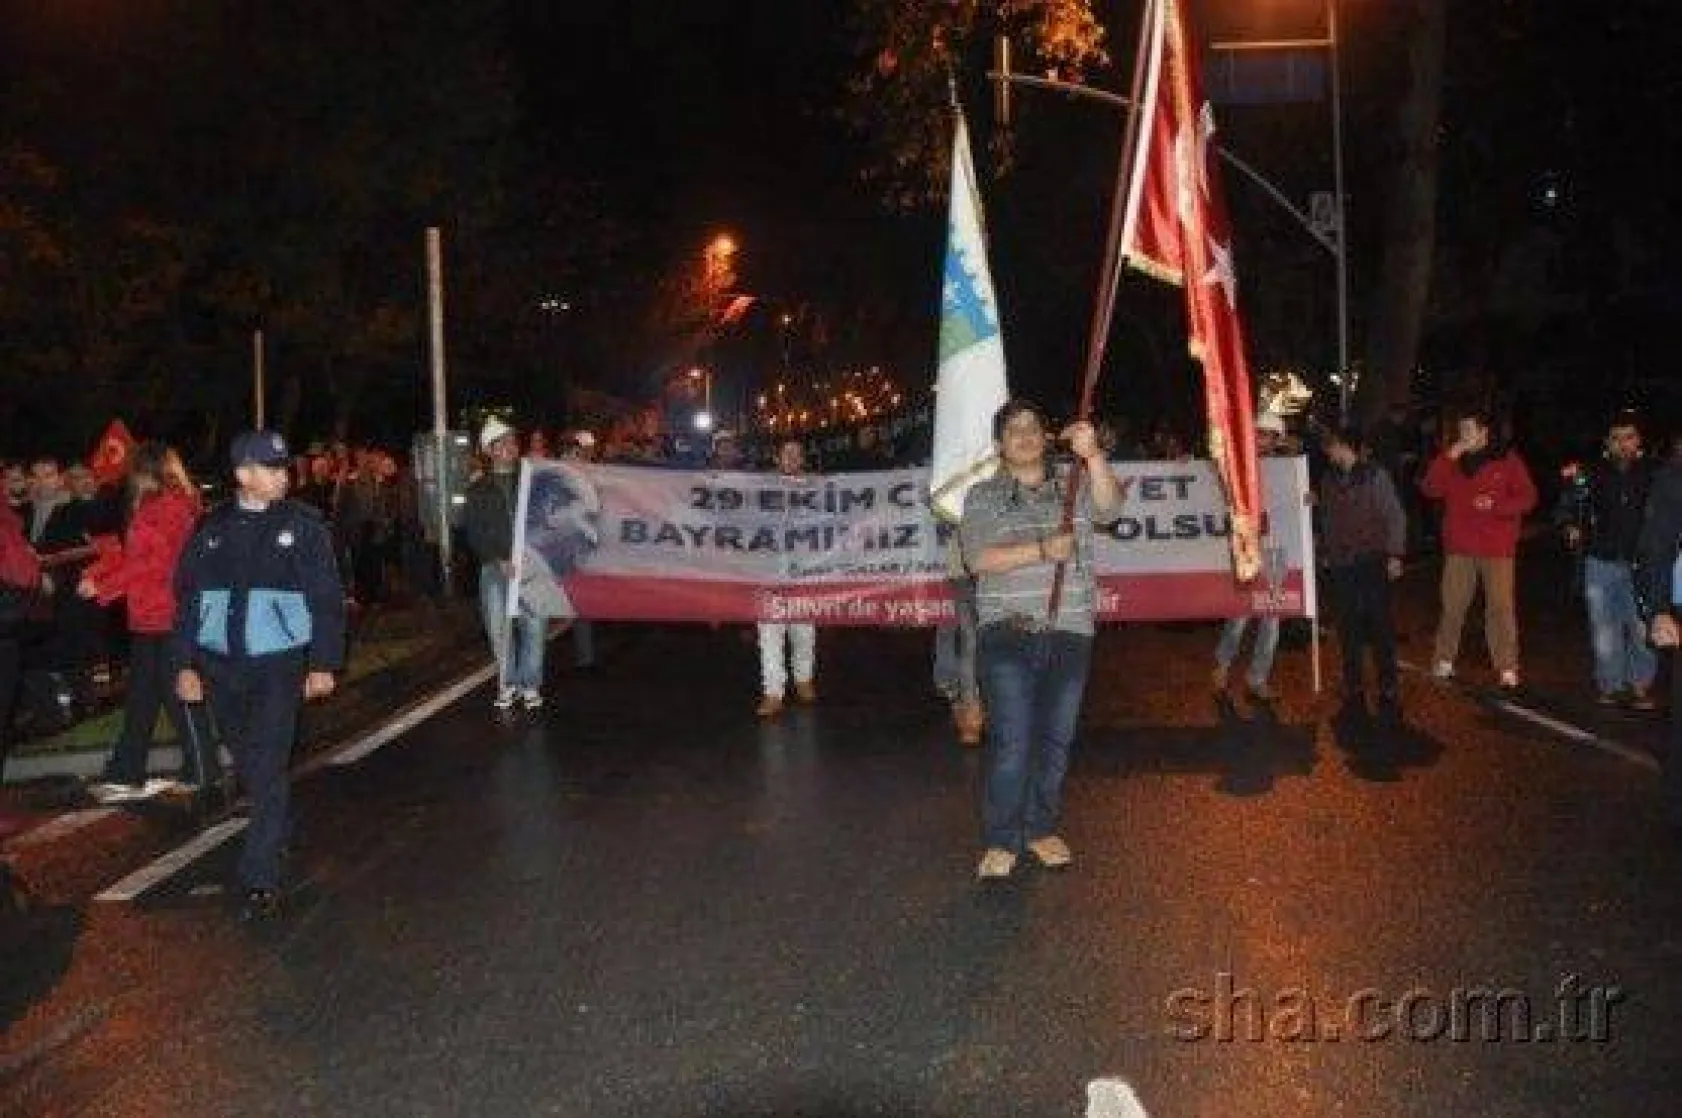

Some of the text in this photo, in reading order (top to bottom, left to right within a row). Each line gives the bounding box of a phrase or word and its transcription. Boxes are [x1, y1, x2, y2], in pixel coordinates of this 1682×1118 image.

[690, 486, 744, 511] 29
[760, 481, 876, 513] EKİM
[1113, 511, 1269, 540] OLSU
